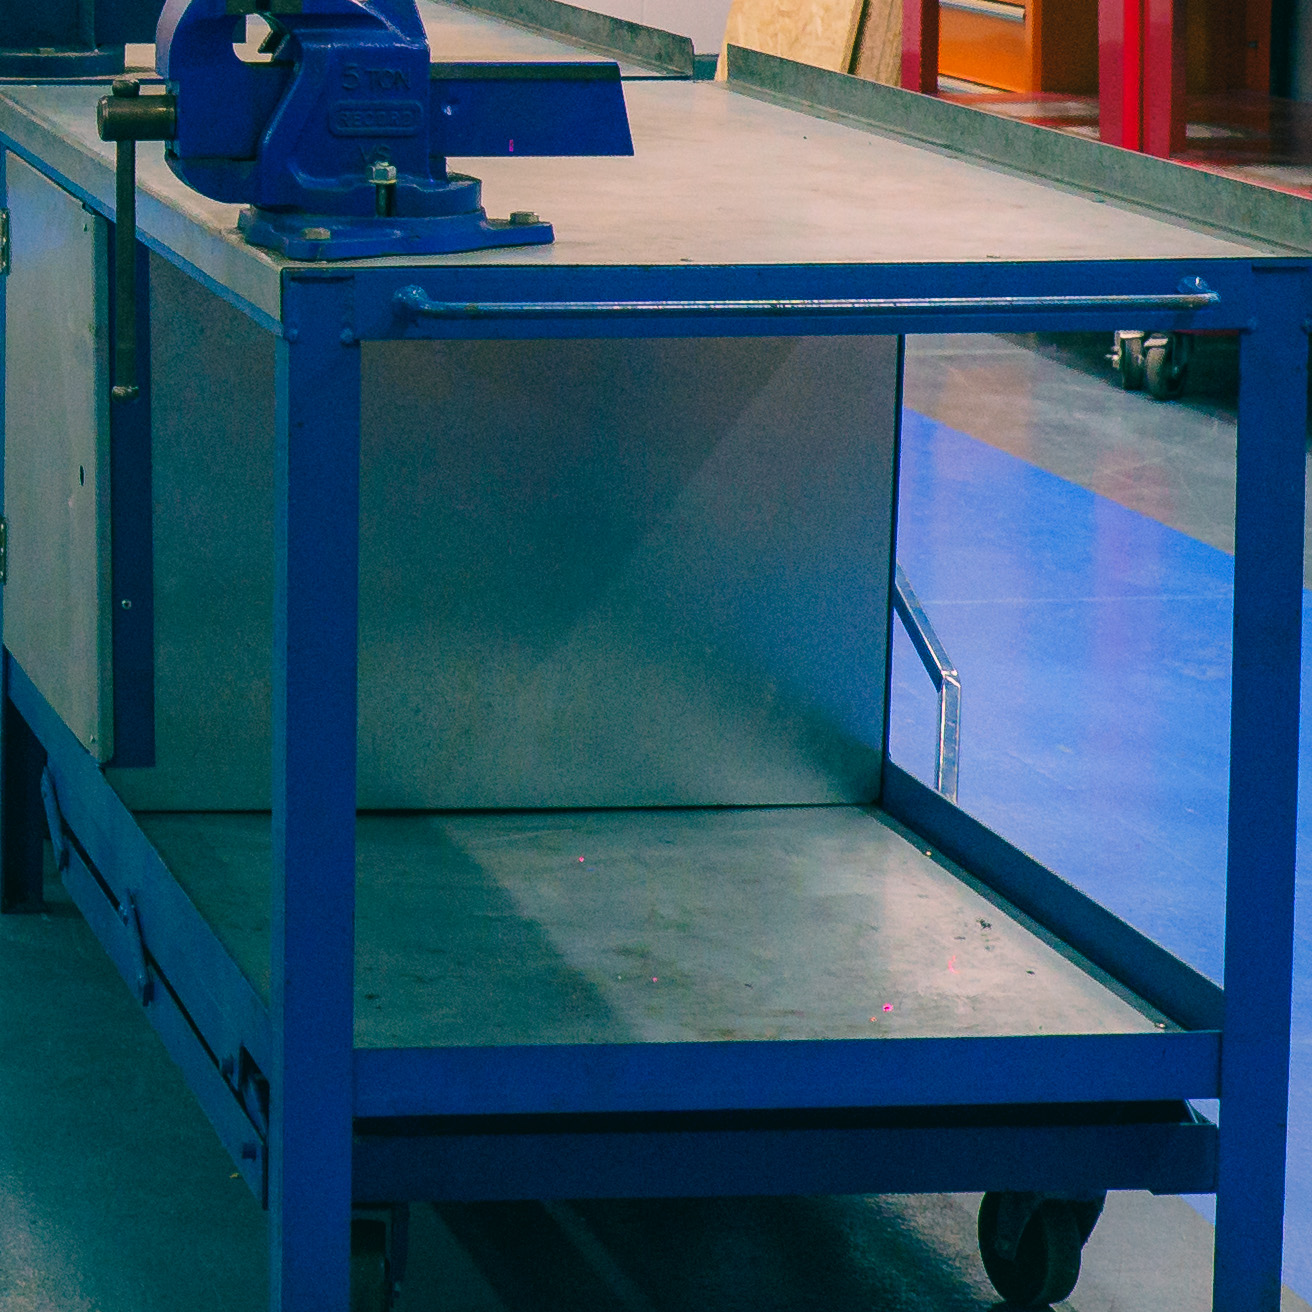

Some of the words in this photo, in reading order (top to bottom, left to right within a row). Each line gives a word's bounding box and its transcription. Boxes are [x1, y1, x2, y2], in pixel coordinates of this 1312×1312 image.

[341, 63, 360, 91] 5
[364, 67, 411, 91] TON
[337, 108, 414, 128] RECORD
